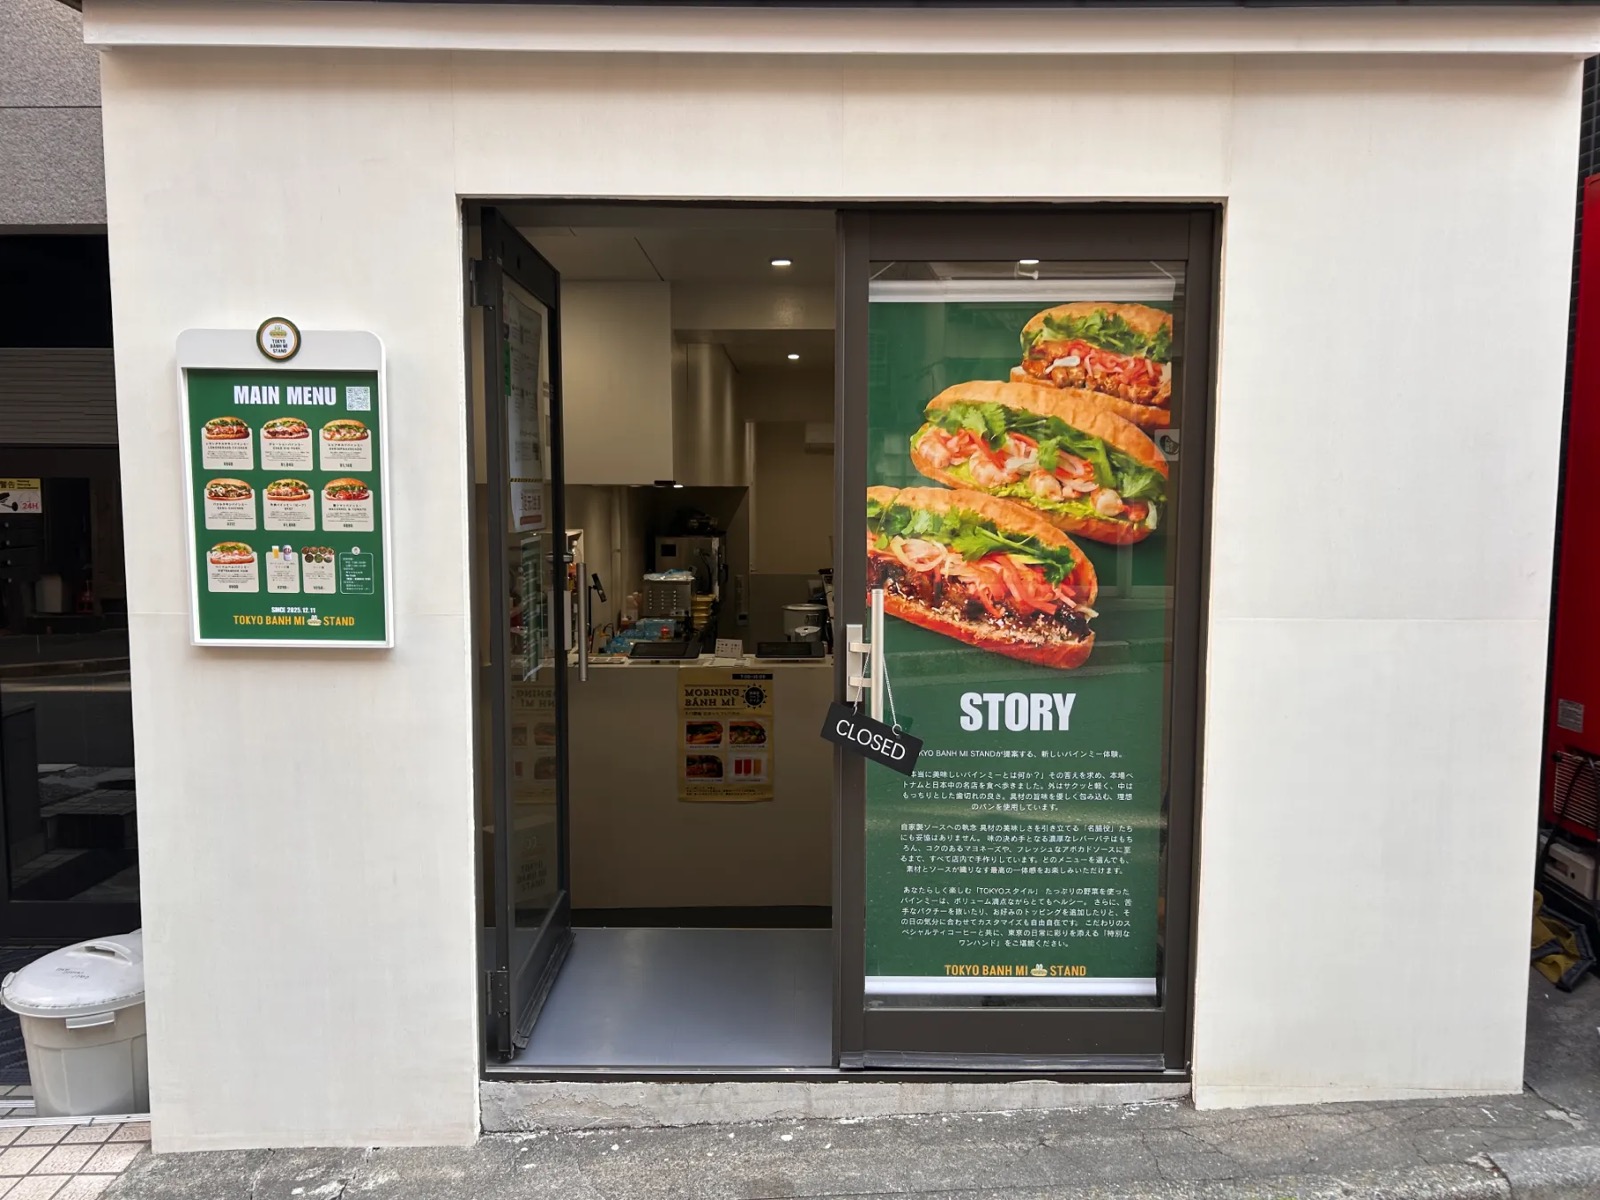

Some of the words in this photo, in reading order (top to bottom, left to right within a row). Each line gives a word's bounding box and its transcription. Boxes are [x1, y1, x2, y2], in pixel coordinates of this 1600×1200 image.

[234, 386, 280, 404] MAIN
[287, 386, 336, 406] MENU
[233, 615, 263, 625] TOKYO
[266, 616, 291, 625] BANH
[294, 616, 304, 625] MI
[323, 616, 355, 626] STAND
[960, 692, 1076, 731] STORY
[836, 720, 906, 760] CLOSED
[971, 803, 1058, 811] のパンを使用しています。
[944, 965, 980, 976] TOKYO
[982, 965, 1012, 976] BANH
[1016, 966, 1028, 976] MI
[1050, 966, 1087, 976] STAND
